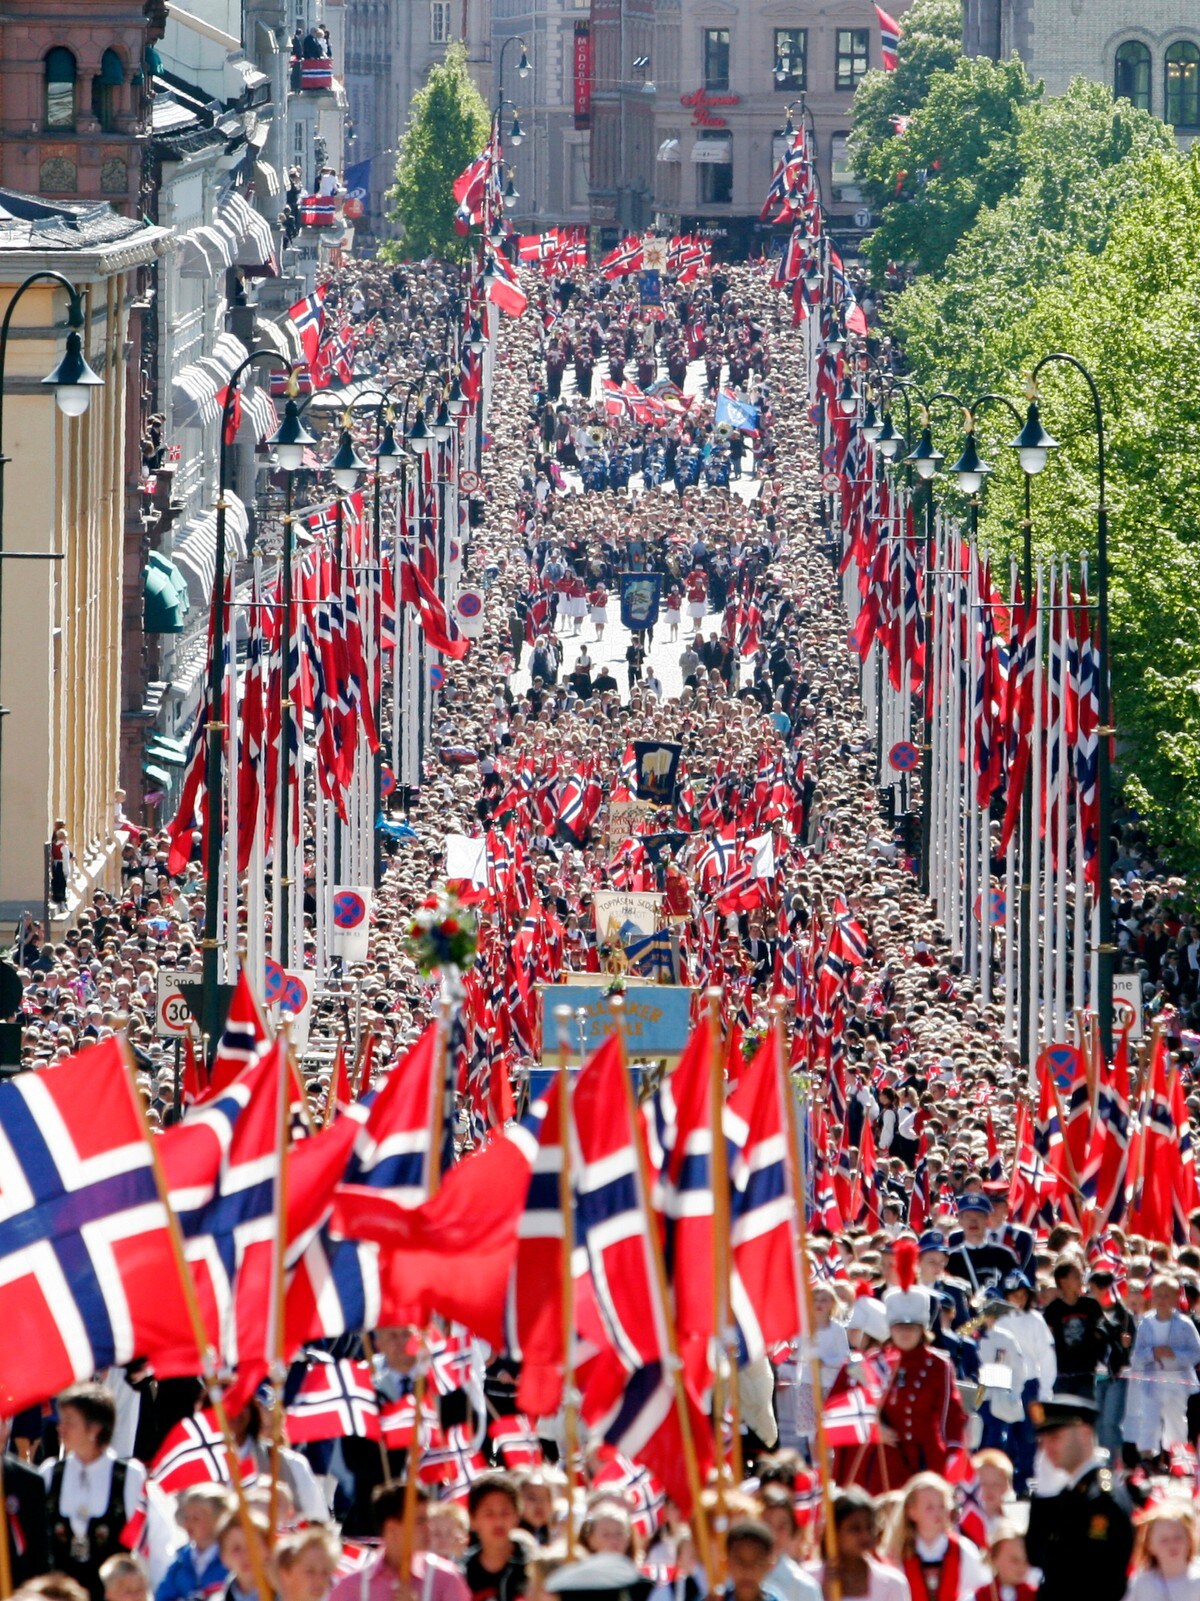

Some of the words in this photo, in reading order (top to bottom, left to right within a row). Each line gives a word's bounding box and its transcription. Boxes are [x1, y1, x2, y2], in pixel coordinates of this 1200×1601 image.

[637, 898, 656, 913] SKOL
[1112, 981, 1133, 991] one
[169, 1003, 190, 1021] 30
[590, 1020, 643, 1036] SKLE
